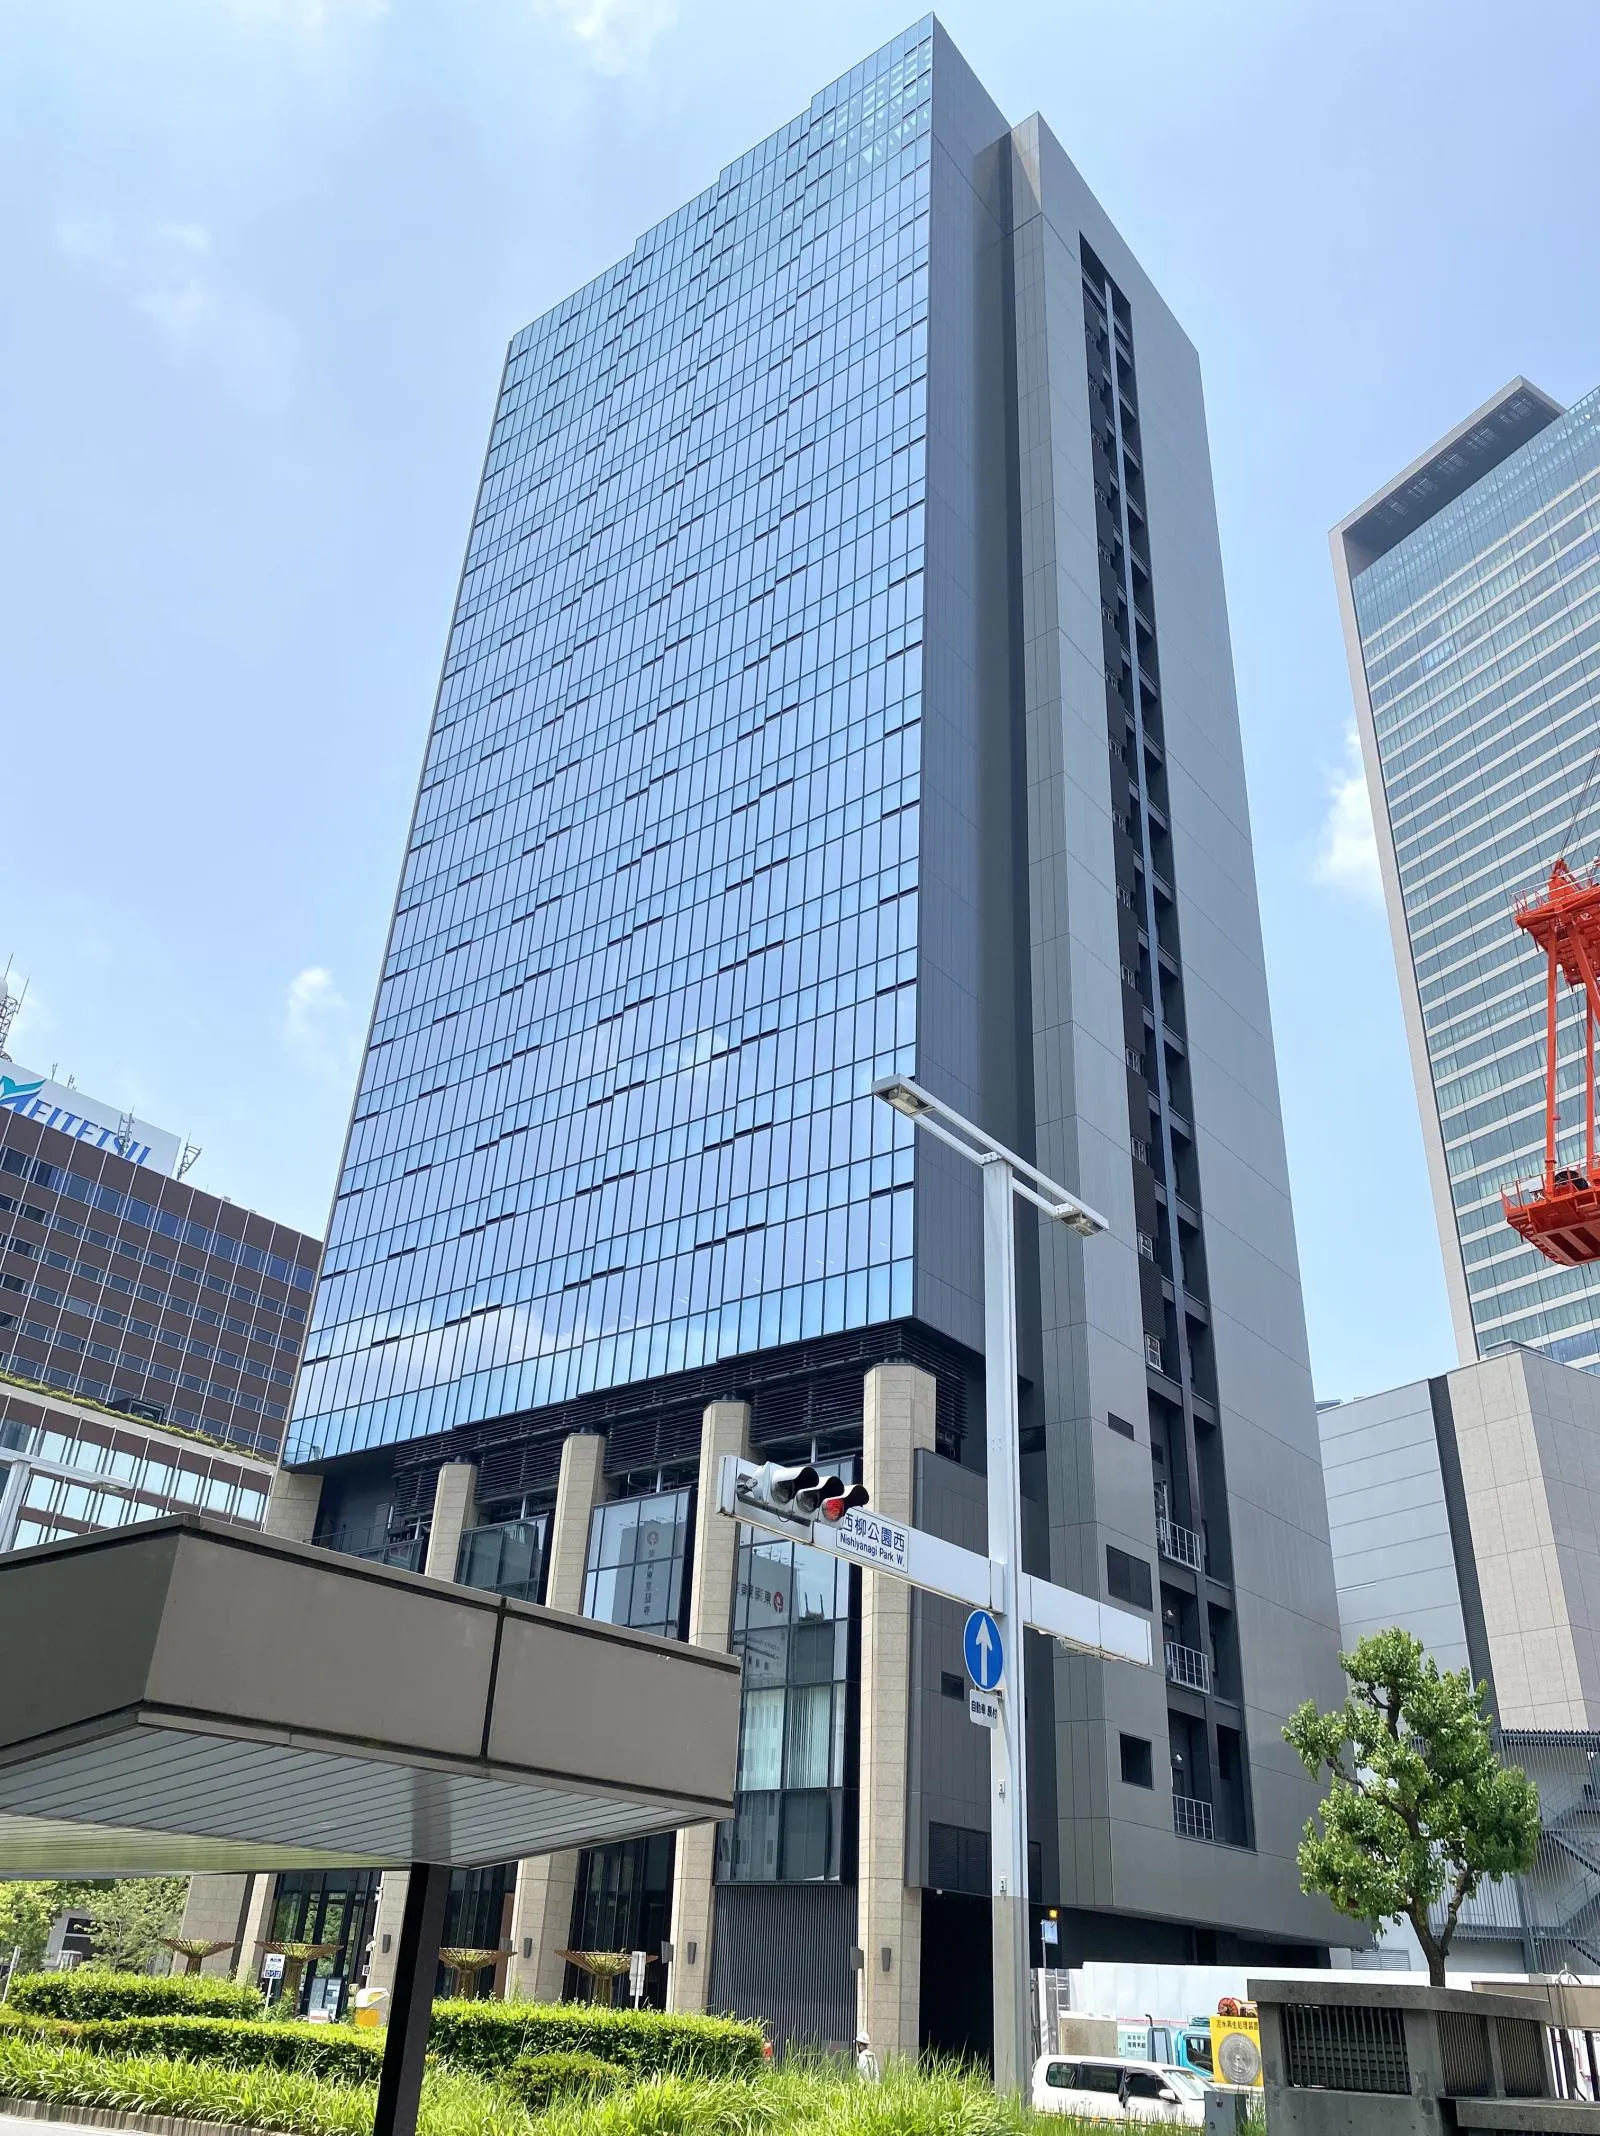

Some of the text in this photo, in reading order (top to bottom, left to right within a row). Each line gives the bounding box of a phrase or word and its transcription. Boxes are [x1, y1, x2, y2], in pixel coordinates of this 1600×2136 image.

[840, 1532, 905, 1567] Nishiyanagi Park W.
[842, 1513, 905, 1552] 西柳公園西
[971, 1700, 998, 1719] 自動車 原付
